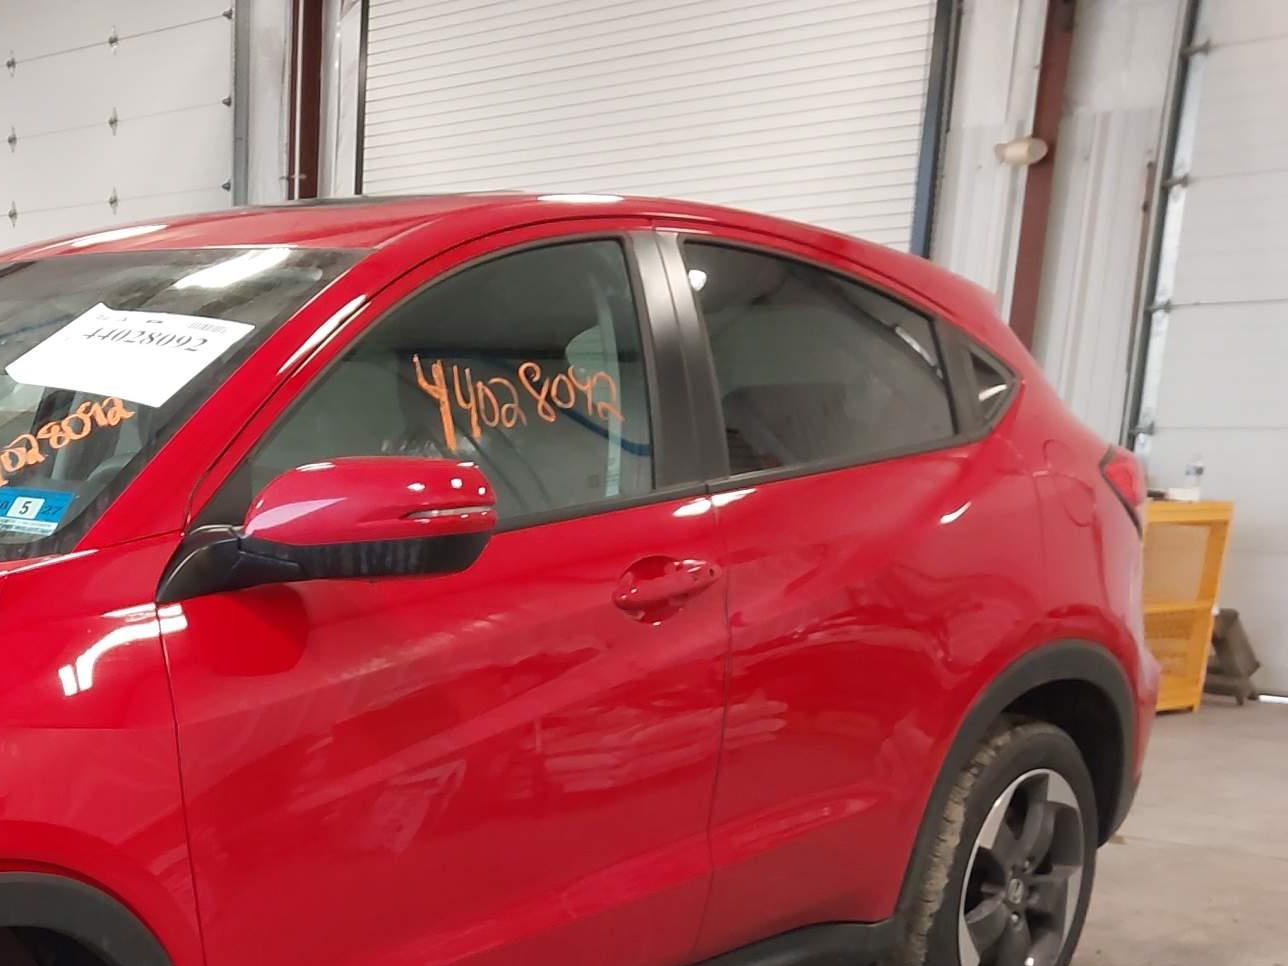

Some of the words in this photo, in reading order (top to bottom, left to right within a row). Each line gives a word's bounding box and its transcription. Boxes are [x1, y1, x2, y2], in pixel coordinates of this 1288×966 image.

[83, 327, 209, 352] 44028092
[413, 353, 625, 452] 44028092
[18, 501, 32, 515] 5
